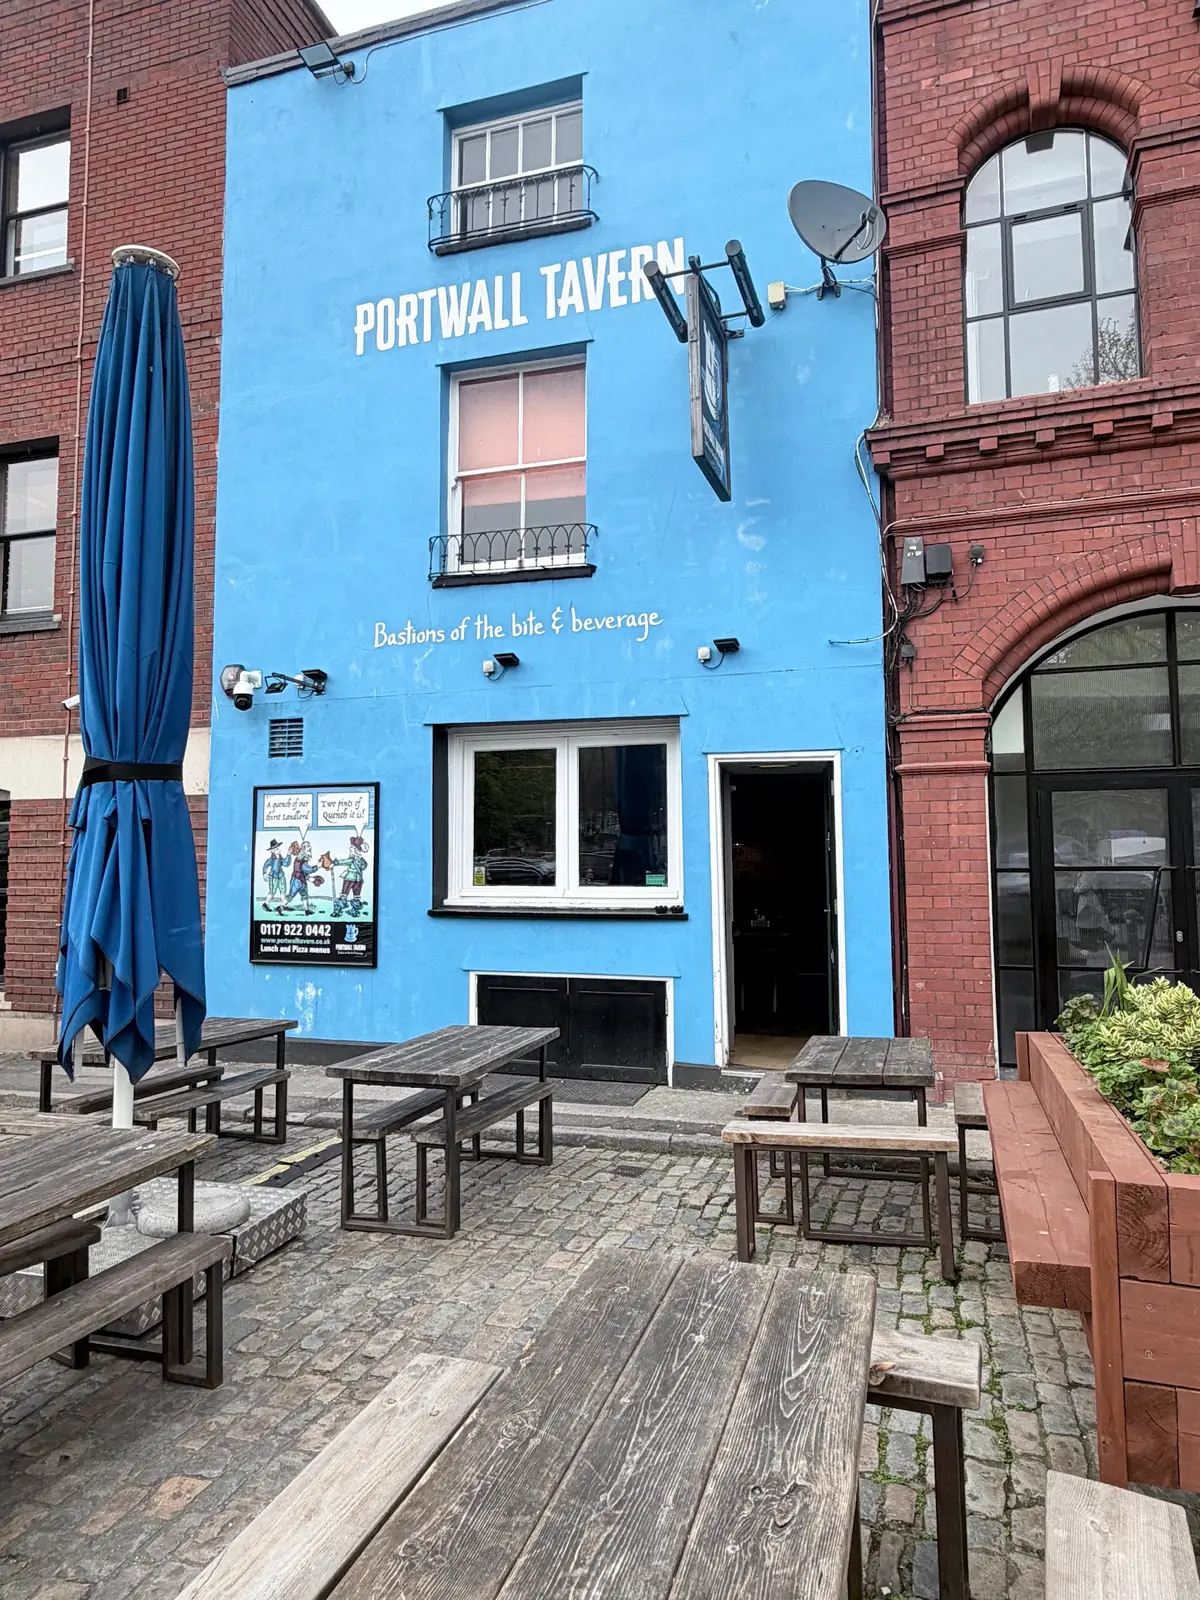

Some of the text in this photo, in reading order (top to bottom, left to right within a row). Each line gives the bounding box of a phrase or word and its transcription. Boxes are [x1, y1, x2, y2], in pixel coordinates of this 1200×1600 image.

[354, 237, 685, 356] PORTWALL TAVERN
[374, 606, 664, 648] Bastions of the bite & beverage
[272, 797, 291, 813] quench
[292, 797, 299, 811] of
[320, 796, 363, 812] Two pints of
[282, 810, 310, 821] Landlord
[322, 807, 348, 824] Quench
[349, 809, 355, 819] it
[260, 923, 332, 937] 0117 922 0442
[260, 943, 279, 953] Lunch
[280, 944, 291, 953] and
[292, 944, 309, 953] Pizza
